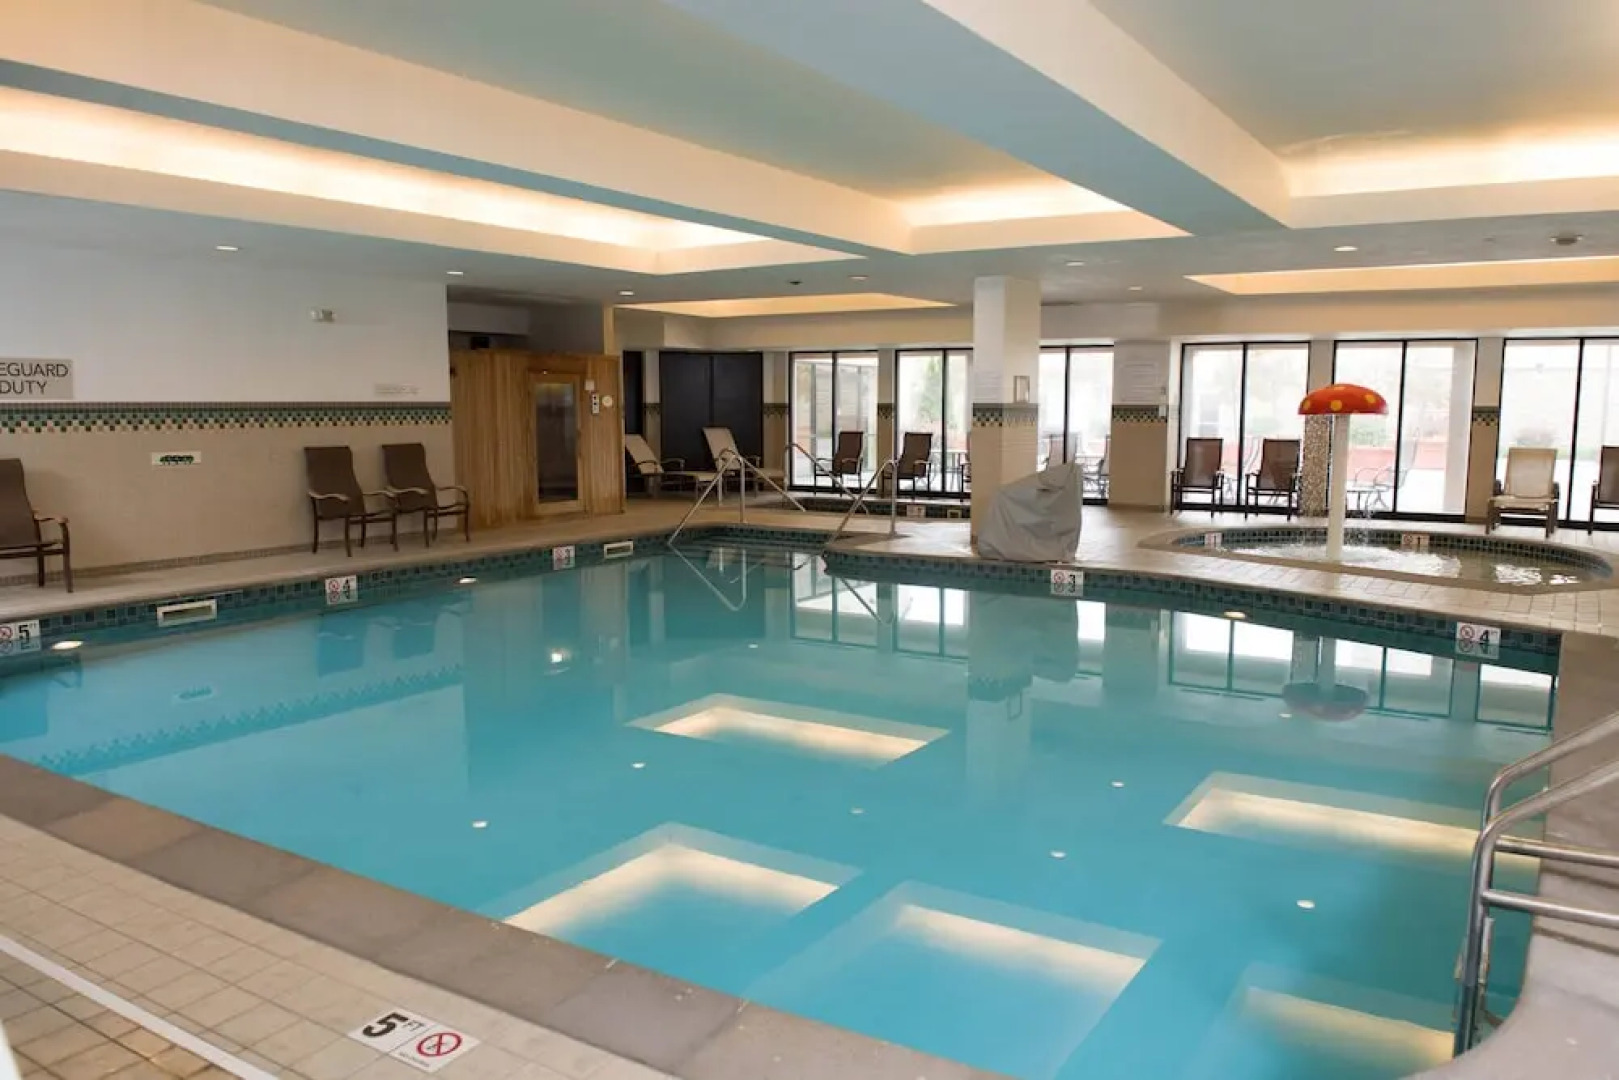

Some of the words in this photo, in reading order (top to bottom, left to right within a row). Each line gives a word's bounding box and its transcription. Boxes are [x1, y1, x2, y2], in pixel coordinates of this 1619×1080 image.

[0, 362, 69, 377] EGUARD
[0, 380, 47, 394] DUTY
[342, 579, 351, 591] 4
[18, 624, 30, 641] 5
[1479, 629, 1489, 643] 4
[362, 1012, 409, 1037] 5
